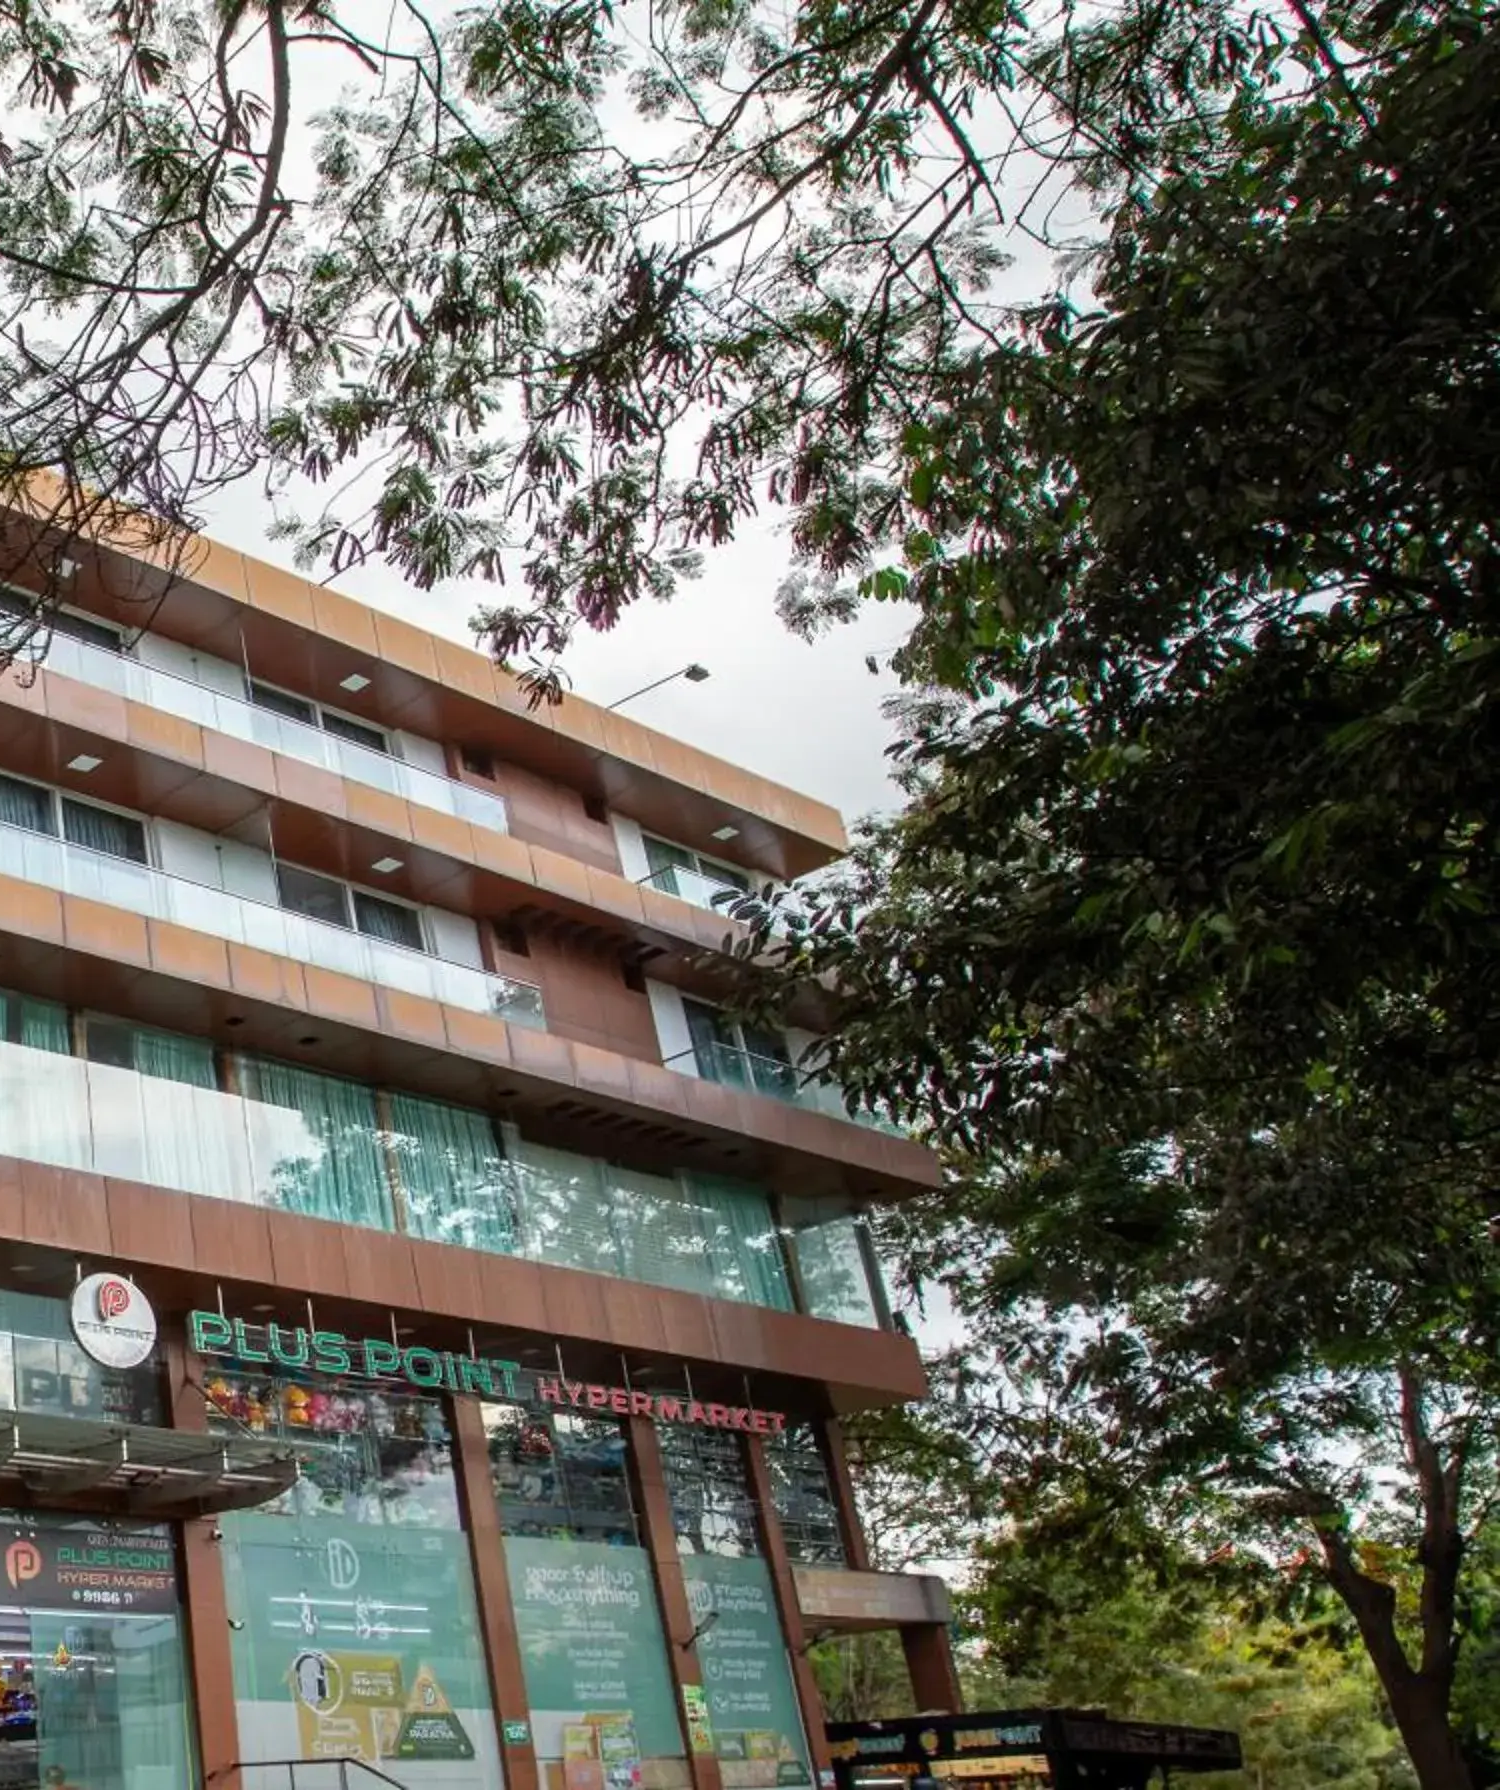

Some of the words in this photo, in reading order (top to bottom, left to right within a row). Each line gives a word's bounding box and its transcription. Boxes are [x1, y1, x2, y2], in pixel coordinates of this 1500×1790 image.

[188, 1309, 351, 1375] PLUS
[363, 1337, 522, 1399] POINT
[537, 1376, 787, 1434] HYPERMARKET
[57, 1547, 111, 1565] PLUS
[114, 1552, 170, 1571] POINT
